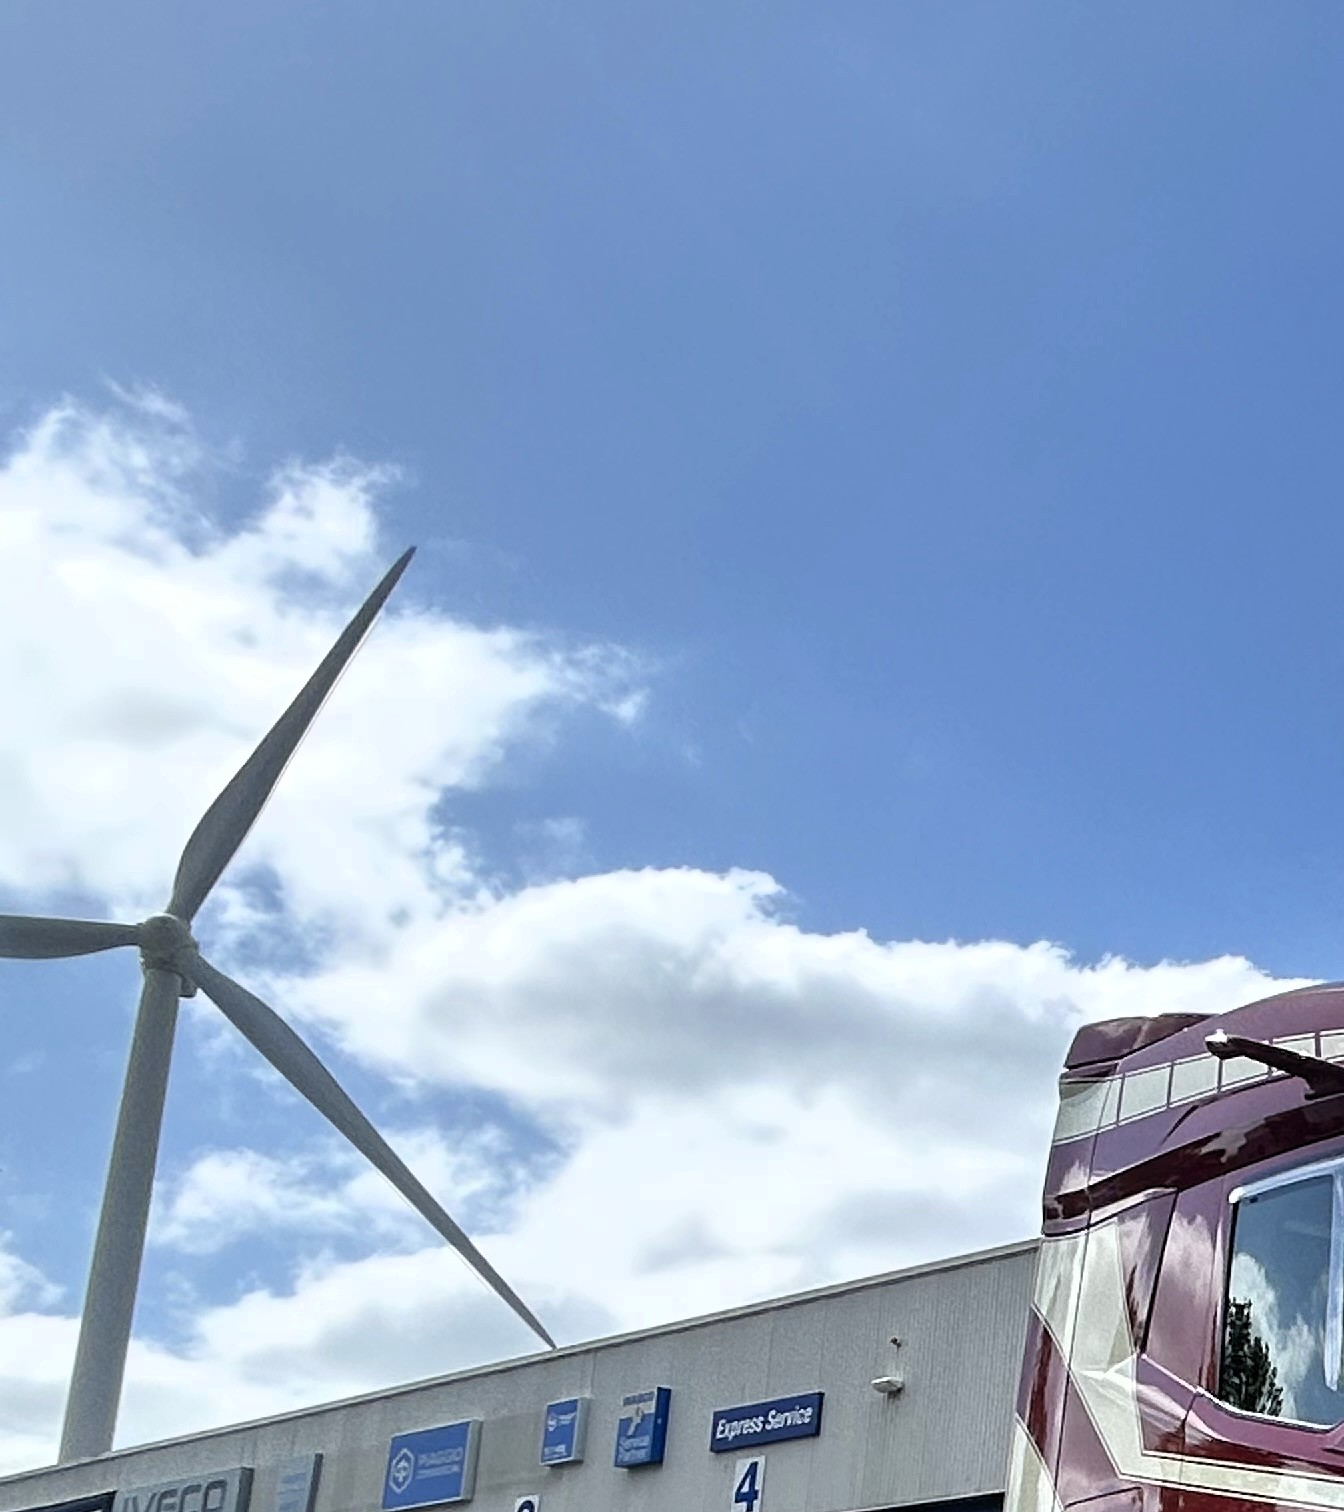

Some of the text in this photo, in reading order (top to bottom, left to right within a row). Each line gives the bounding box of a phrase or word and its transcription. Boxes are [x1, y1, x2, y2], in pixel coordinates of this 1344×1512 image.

[715, 1404, 814, 1441] Express Service
[735, 1460, 760, 1512] 4
